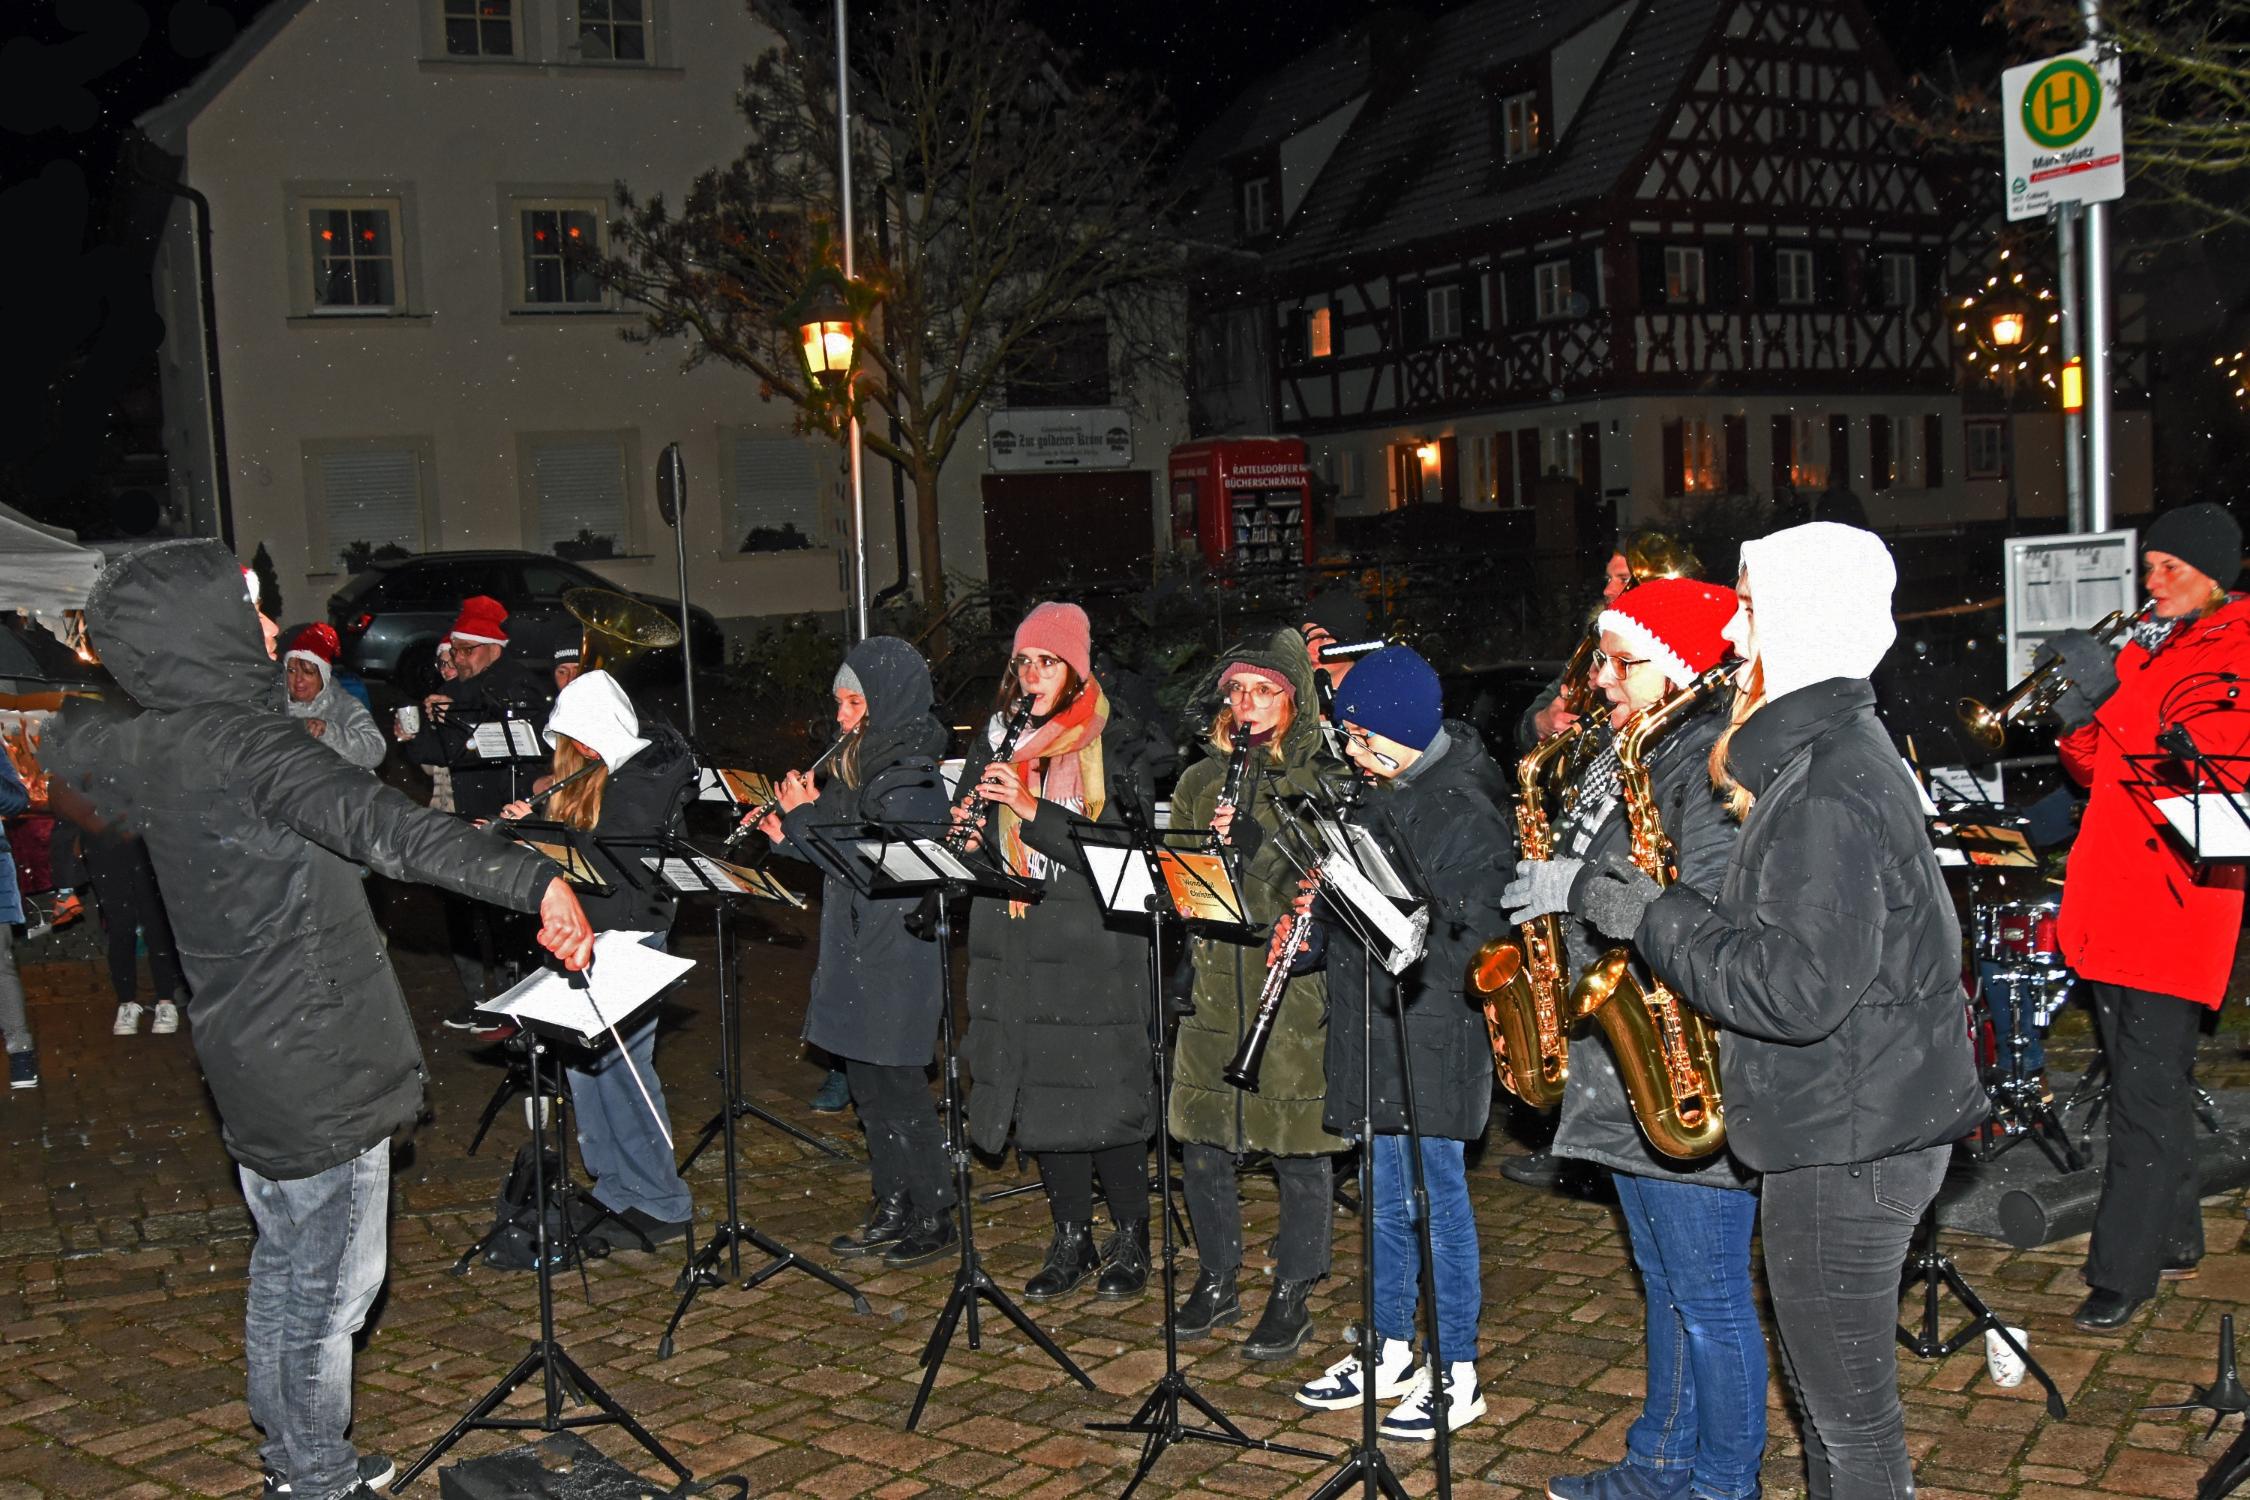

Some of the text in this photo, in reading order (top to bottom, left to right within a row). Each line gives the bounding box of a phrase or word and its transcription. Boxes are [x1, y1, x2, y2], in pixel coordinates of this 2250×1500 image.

[2045, 76, 2078, 131] H
[1233, 463, 1298, 474] RATTELSDORFER
[1225, 476, 1308, 489] BÜCHERSCHRÄNKLA
